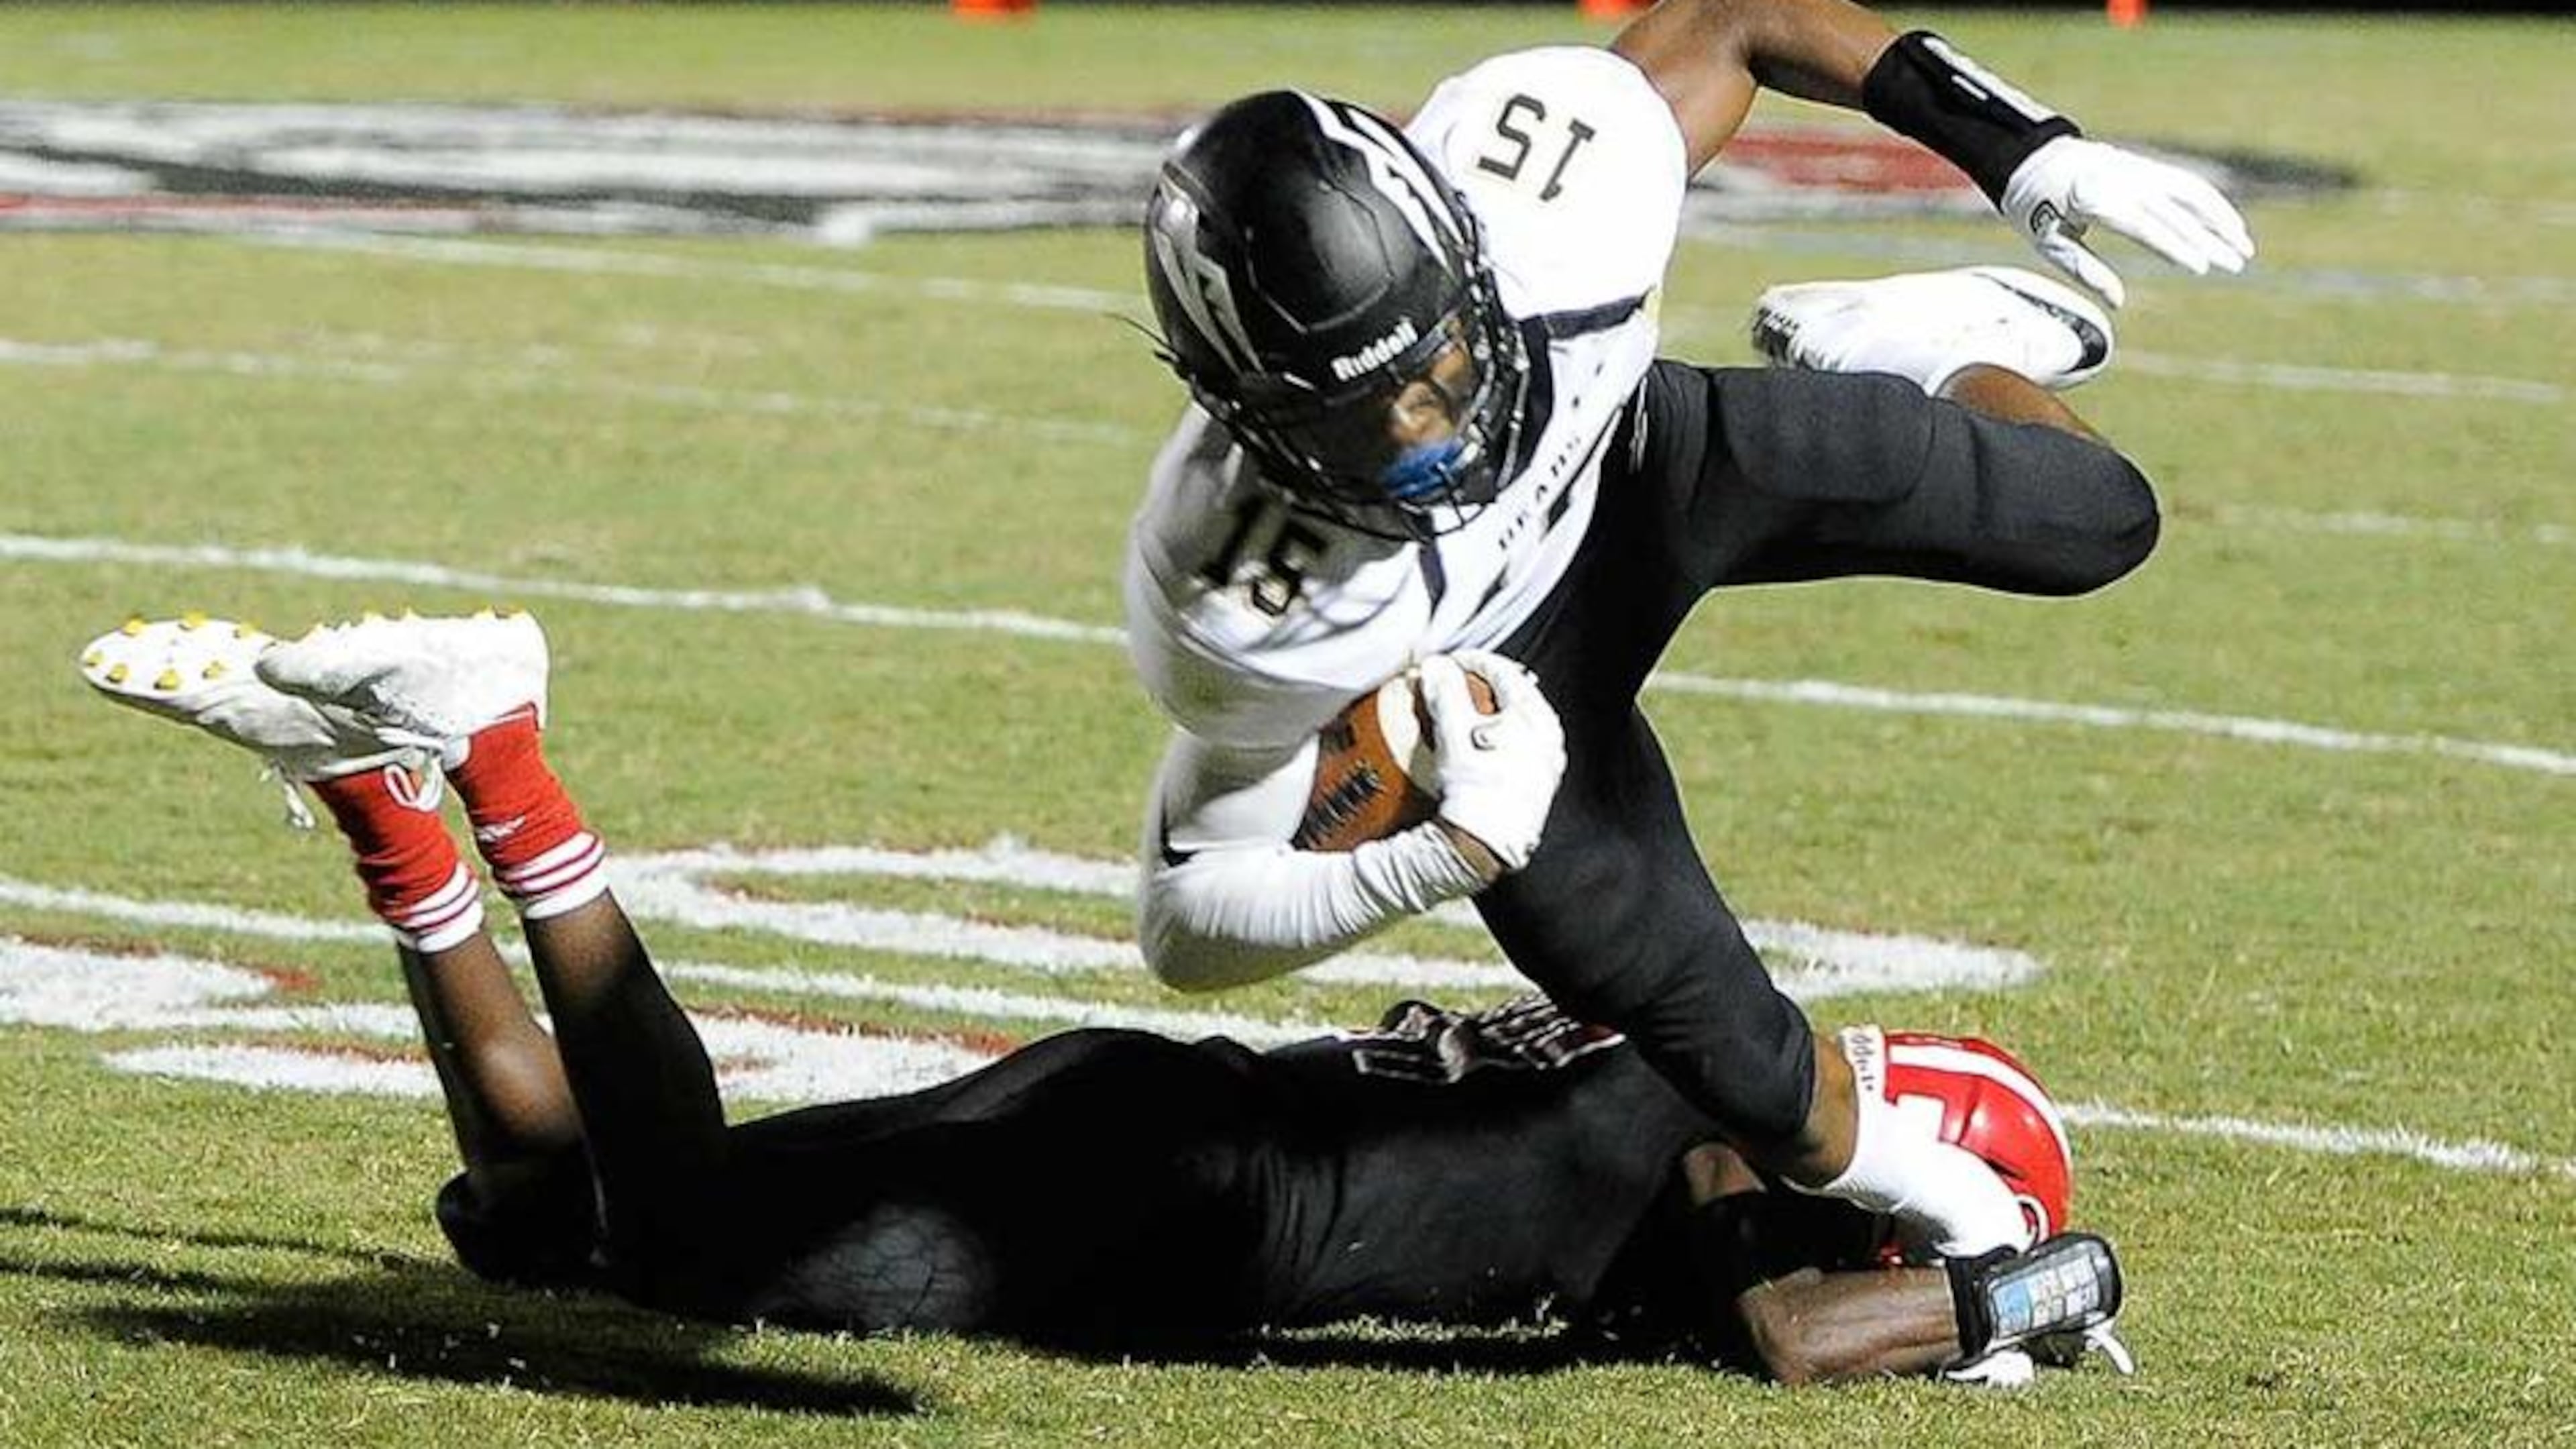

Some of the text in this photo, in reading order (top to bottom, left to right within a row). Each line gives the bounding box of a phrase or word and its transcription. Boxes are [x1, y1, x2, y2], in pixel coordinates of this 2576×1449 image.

[1477, 93, 1596, 203] 15
[1331, 315, 1419, 382] Riddell
[1198, 494, 1330, 617] 15
